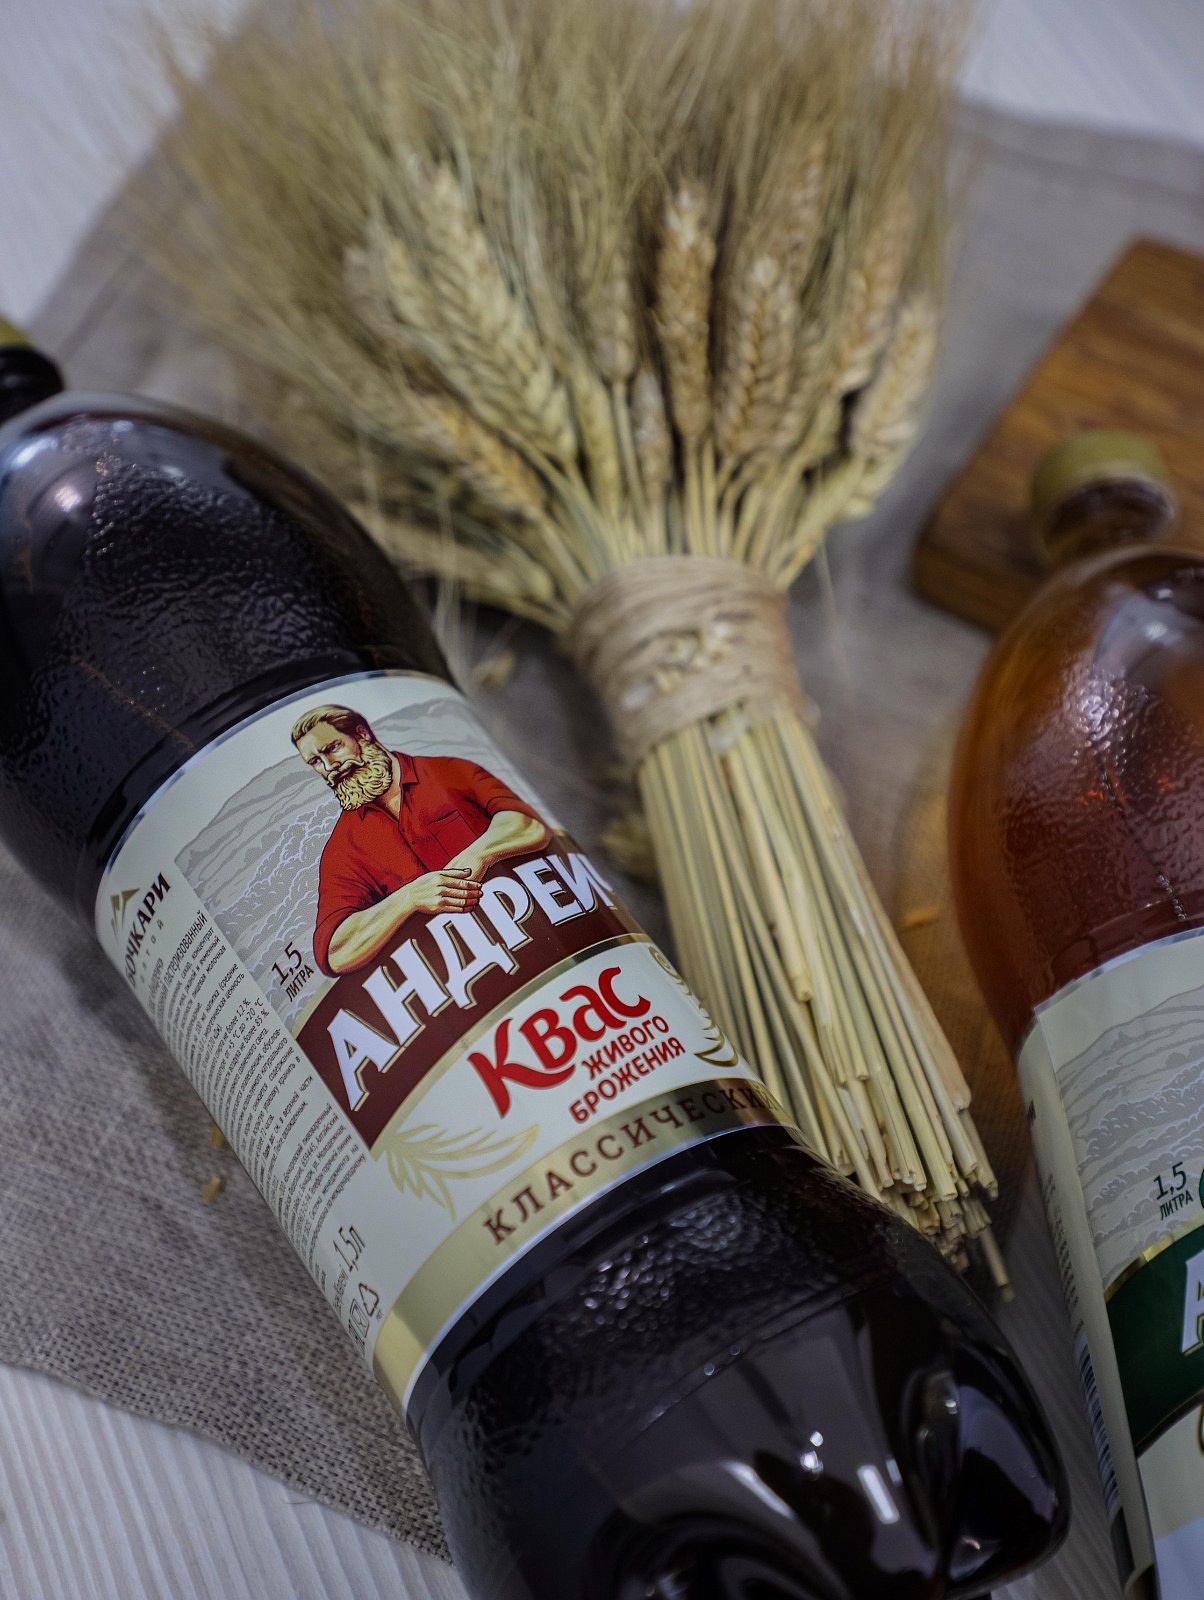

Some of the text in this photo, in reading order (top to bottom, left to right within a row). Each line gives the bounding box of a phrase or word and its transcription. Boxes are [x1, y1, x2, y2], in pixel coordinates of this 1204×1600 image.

[162, 908, 208, 987] пастеризованный
[190, 926, 214, 960] концентрат
[199, 933, 220, 967] ячменный
[205, 943, 226, 974] молочная
[271, 941, 302, 986] 1,5
[204, 988, 220, 1013] напитка
[217, 961, 239, 992] (средние
[224, 970, 245, 1001] ценность
[285, 964, 315, 1003] ЛИТРА
[327, 852, 618, 1112] АНДРЕИ
[224, 1014, 239, 1034] более
[235, 1002, 246, 1018] 1,2
[238, 1021, 247, 1035] до
[244, 1005, 256, 1024] +20
[242, 1023, 257, 1044] более
[254, 1014, 263, 1028] 85
[237, 1041, 257, 1075] солнечного
[254, 1025, 269, 1046] света.
[239, 1040, 246, 1053] не
[260, 1025, 282, 1055] обуслов-
[260, 1035, 288, 1076] натурального
[580, 1015, 670, 1081] ЖИВОГО
[251, 1081, 268, 1113] снижается
[268, 1044, 294, 1083] содержание
[262, 1083, 280, 1112] упаковку
[277, 1060, 296, 1088] хранить
[295, 1055, 301, 1063] в
[281, 1089, 300, 1119] верхней
[298, 1073, 313, 1094] части
[569, 1037, 687, 1123] БРОЖЕНИЯ
[300, 1101, 333, 1147] пивоваренный
[314, 1110, 339, 1145] Алтайский
[315, 1121, 346, 1162] Молодежная,
[320, 1153, 350, 1196] менеджмента
[349, 1142, 359, 1155] на
[321, 1148, 339, 1176] горячей
[336, 1132, 352, 1155] линии
[329, 1152, 367, 1203] международному
[1153, 1161, 1187, 1200] 1,5
[1160, 1189, 1194, 1221] ЛИТРА
